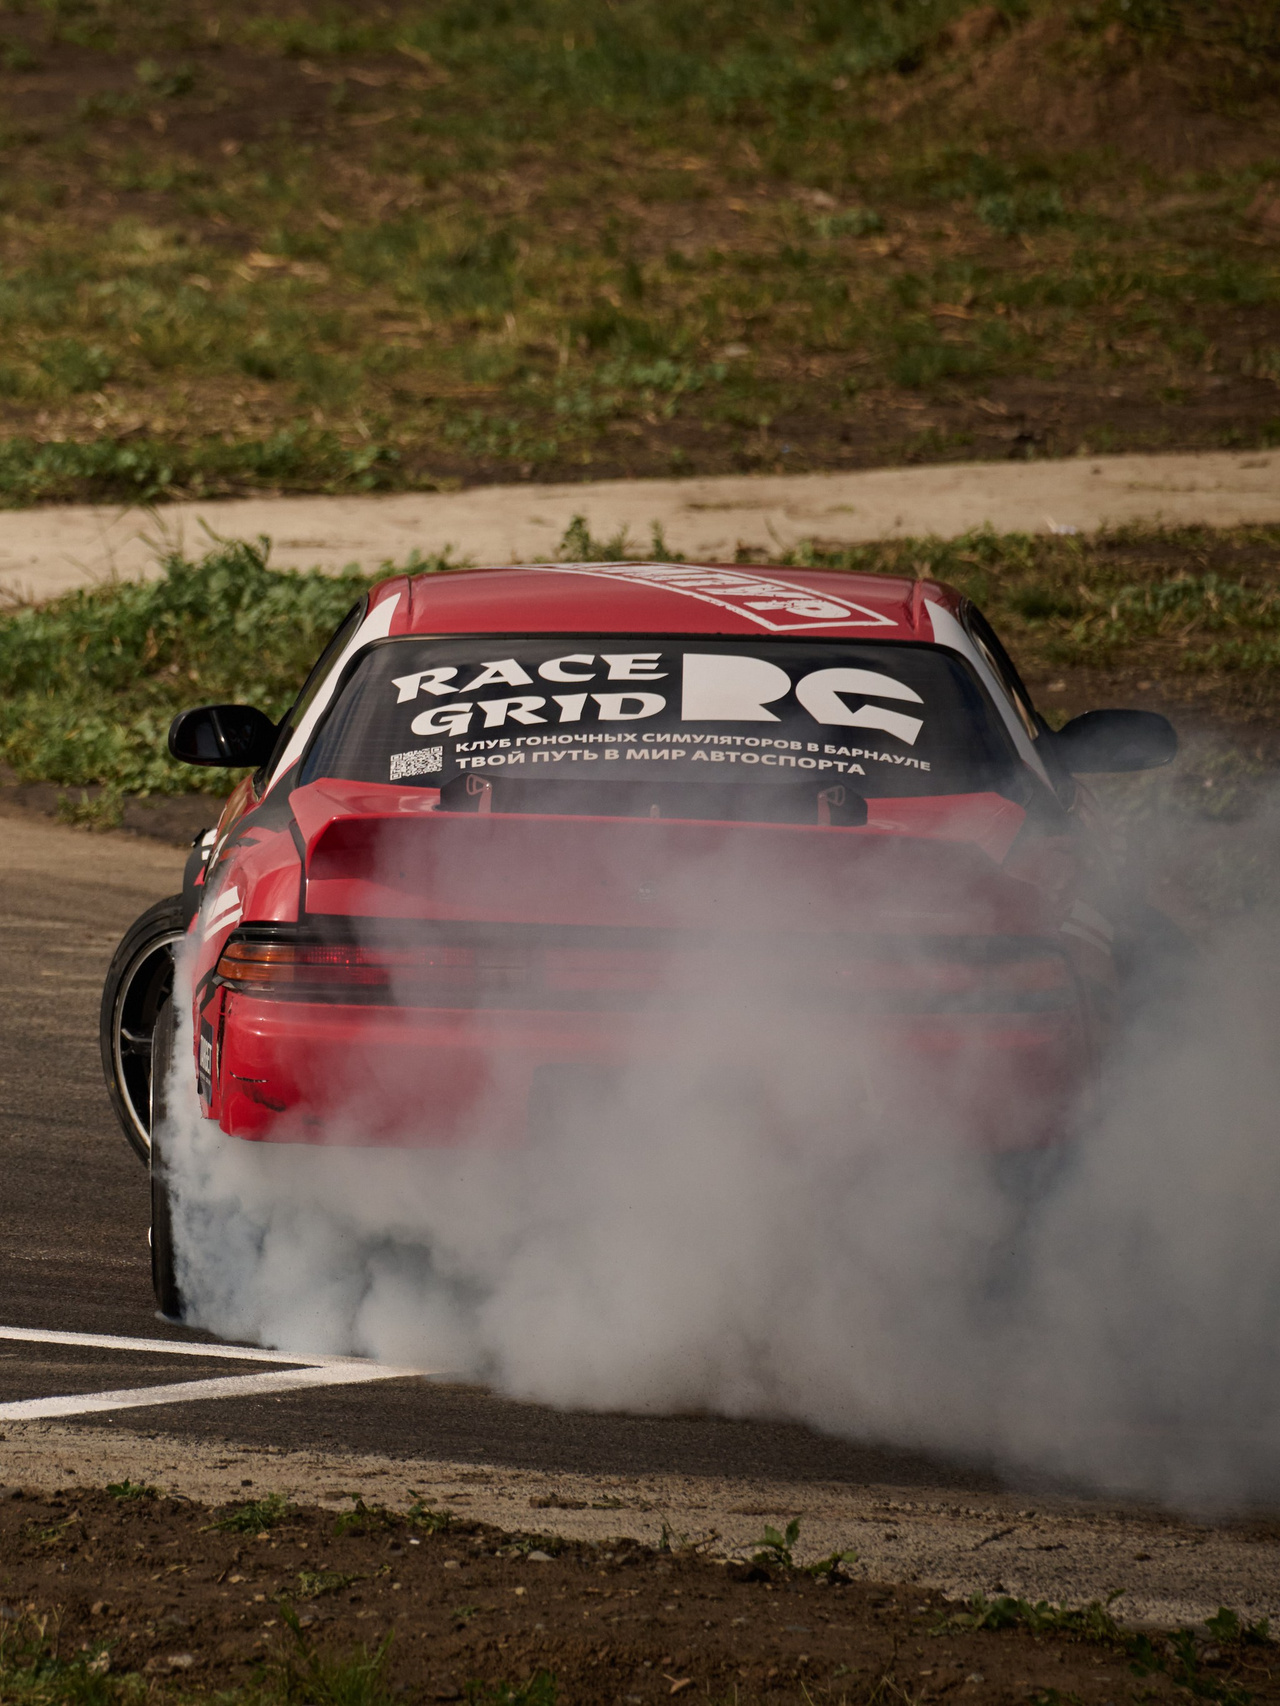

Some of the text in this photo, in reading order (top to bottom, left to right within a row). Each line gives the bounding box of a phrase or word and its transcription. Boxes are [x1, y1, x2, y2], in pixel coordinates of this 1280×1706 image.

[390, 653, 669, 704] RACE
[410, 692, 667, 737] GRID
[455, 733, 932, 772] КЛУБ ГОНОЧНЫХ СИМУЛЯТОРОВ В БАРНАУЛЕ
[455, 748, 866, 776] ТВОЙ ПУТЬ В МИР АВТОСПОРТА
